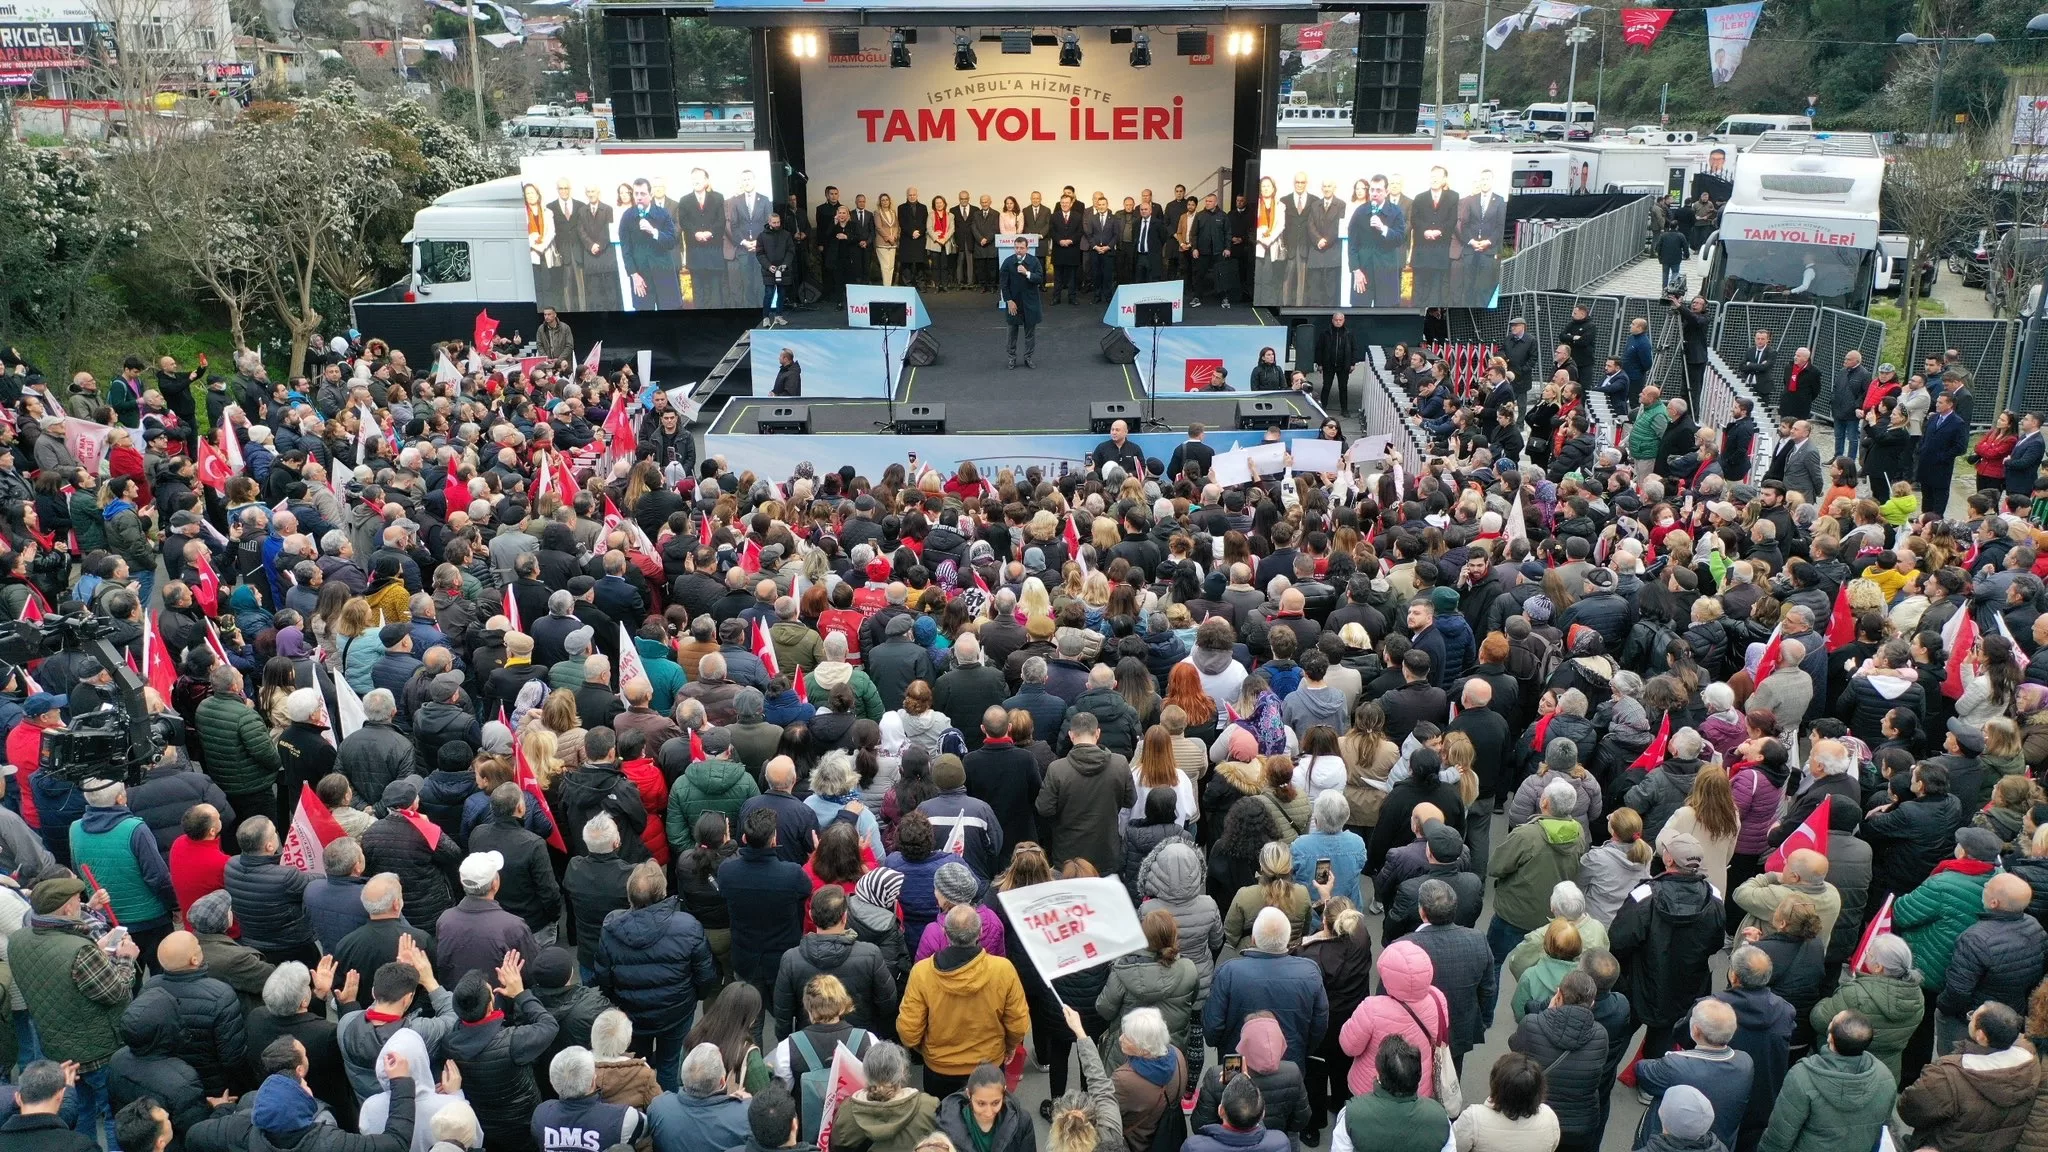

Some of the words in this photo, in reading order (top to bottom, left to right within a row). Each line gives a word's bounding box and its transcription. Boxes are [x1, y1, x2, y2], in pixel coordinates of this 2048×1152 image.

[1303, 30, 1324, 38] CHP
[1721, 20, 1748, 31] İLERİ
[1193, 54, 1211, 62] CHP
[926, 78, 1024, 105] İSTANBUL'A
[1031, 77, 1112, 104] HİZMETTE
[857, 108, 956, 143] TAM
[966, 107, 1056, 142] YOL
[1070, 96, 1184, 141] İLERİ
[1744, 228, 1776, 240] TAM
[1780, 230, 1809, 243] YOL
[1813, 230, 1856, 246] İLERİ
[849, 305, 868, 315] TAM
[1024, 908, 1060, 930] TAM
[1063, 903, 1096, 918] YOL
[1042, 917, 1087, 944] İLERİ
[543, 1126, 600, 1152] DMS
